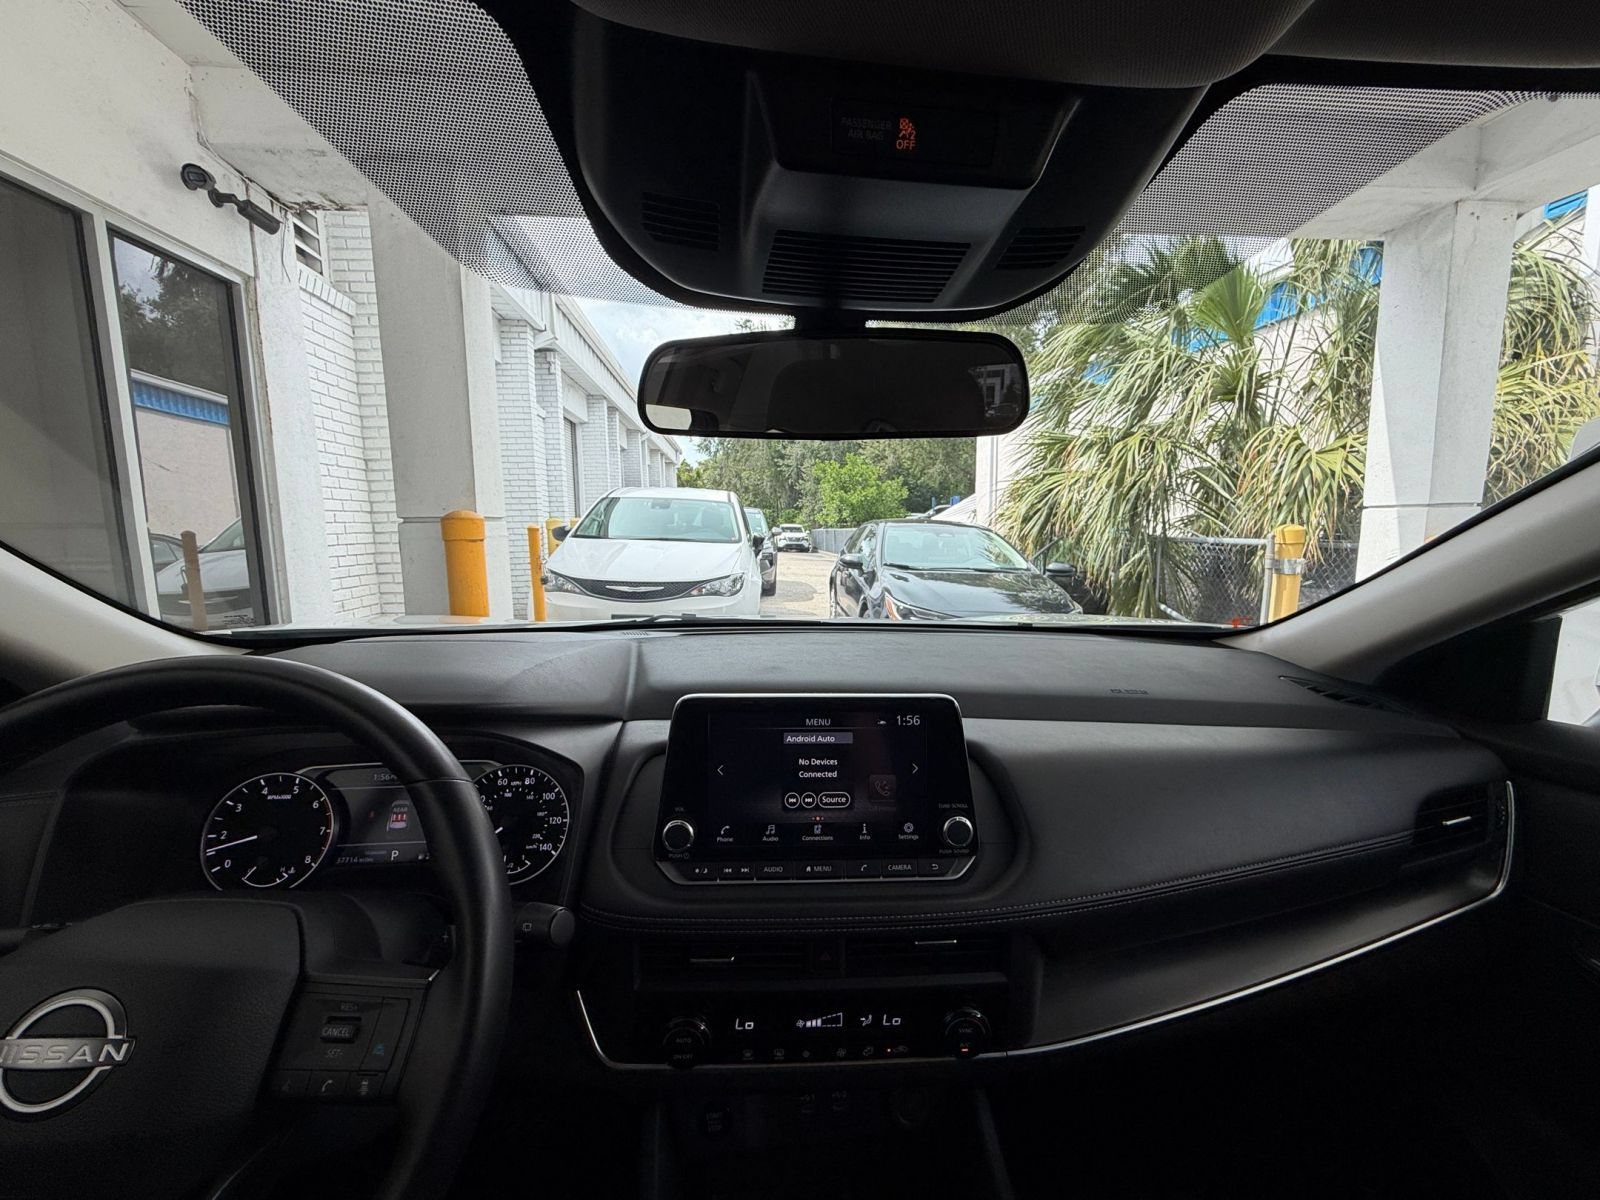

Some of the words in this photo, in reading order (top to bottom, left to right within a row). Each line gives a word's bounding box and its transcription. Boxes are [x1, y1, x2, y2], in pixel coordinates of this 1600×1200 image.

[896, 139, 916, 150] OFF
[805, 718, 831, 726] MENU
[896, 715, 921, 726] 1:56
[786, 734, 816, 742] Android
[817, 734, 835, 742] Auto
[798, 758, 810, 766] No
[810, 757, 838, 766] Devices
[798, 769, 838, 778] Connected
[497, 778, 508, 786] 60
[524, 777, 535, 785] 80
[261, 787, 268, 795] 4
[293, 785, 300, 794] 5
[821, 795, 846, 804] Source
[235, 803, 243, 812] 3
[312, 800, 319, 809] 6
[549, 816, 562, 825] 120
[220, 830, 227, 840] 2
[319, 826, 325, 836] 7
[716, 835, 734, 843] Phone
[762, 834, 779, 842] Audio
[859, 833, 871, 841] Info
[897, 833, 919, 841] Settings
[539, 843, 552, 851] 140
[304, 855, 311, 864] 8
[391, 850, 399, 861] P
[224, 859, 231, 868] 0
[887, 863, 912, 871] CAMERA
[763, 865, 783, 873] AUDIO
[735, 1017, 754, 1030] Lo
[883, 1013, 901, 1026] Lo
[321, 1026, 350, 1037] CANCEL
